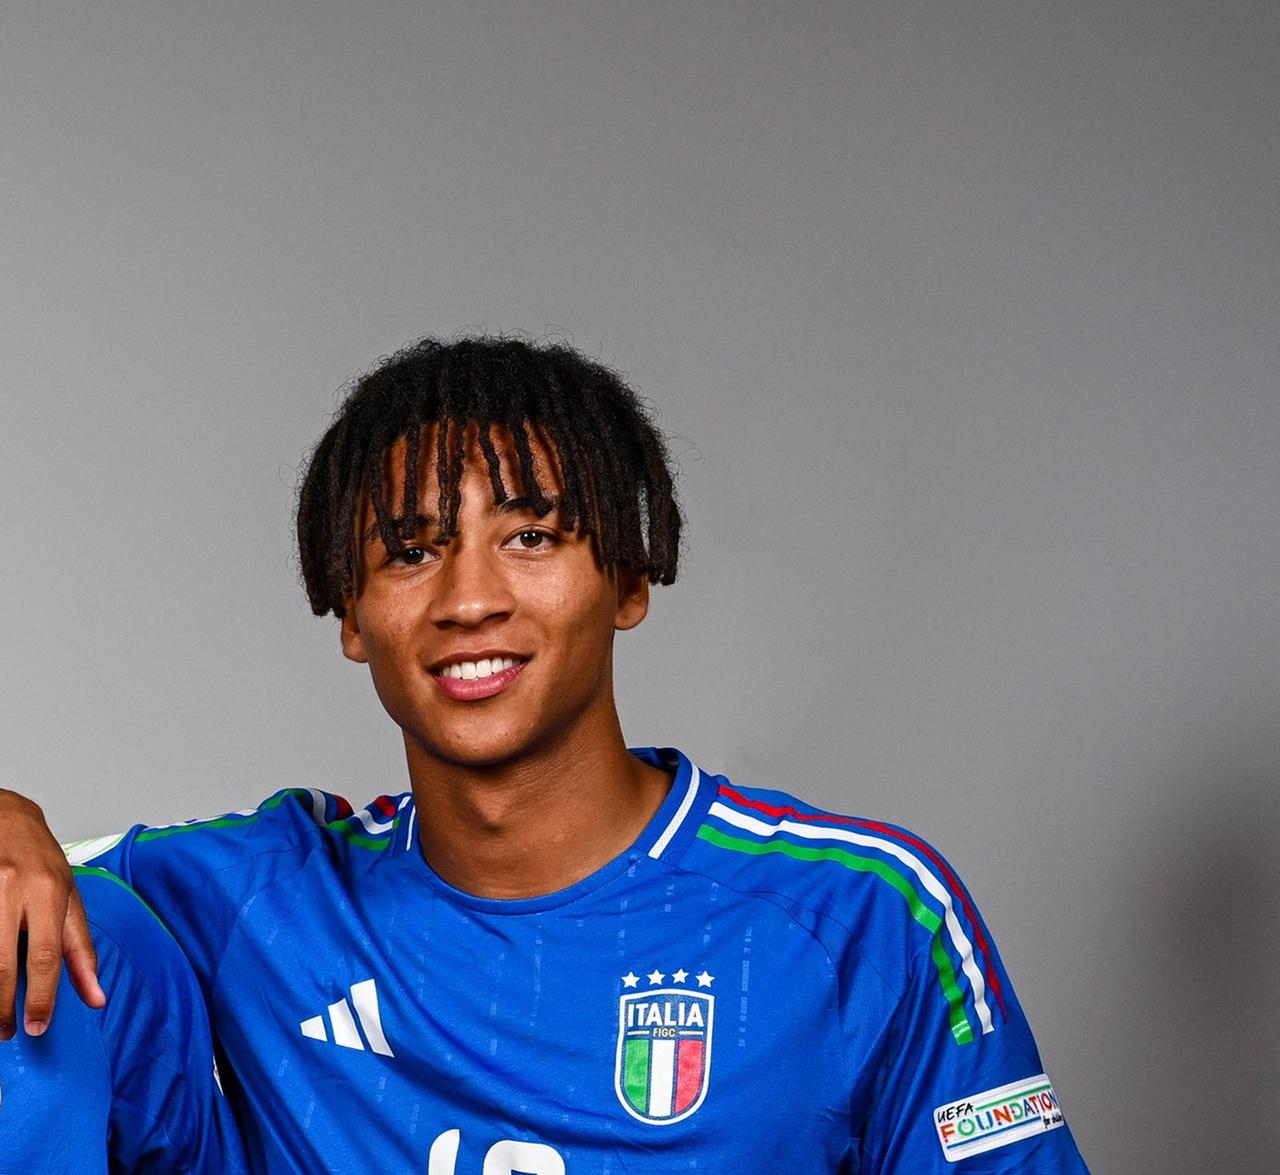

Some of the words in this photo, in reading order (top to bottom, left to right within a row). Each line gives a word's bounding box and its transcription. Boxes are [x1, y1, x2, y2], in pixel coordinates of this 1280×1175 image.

[627, 1002, 705, 1028] ITALIA
[652, 1027, 676, 1038] FIGC
[937, 1102, 974, 1123] UEFA
